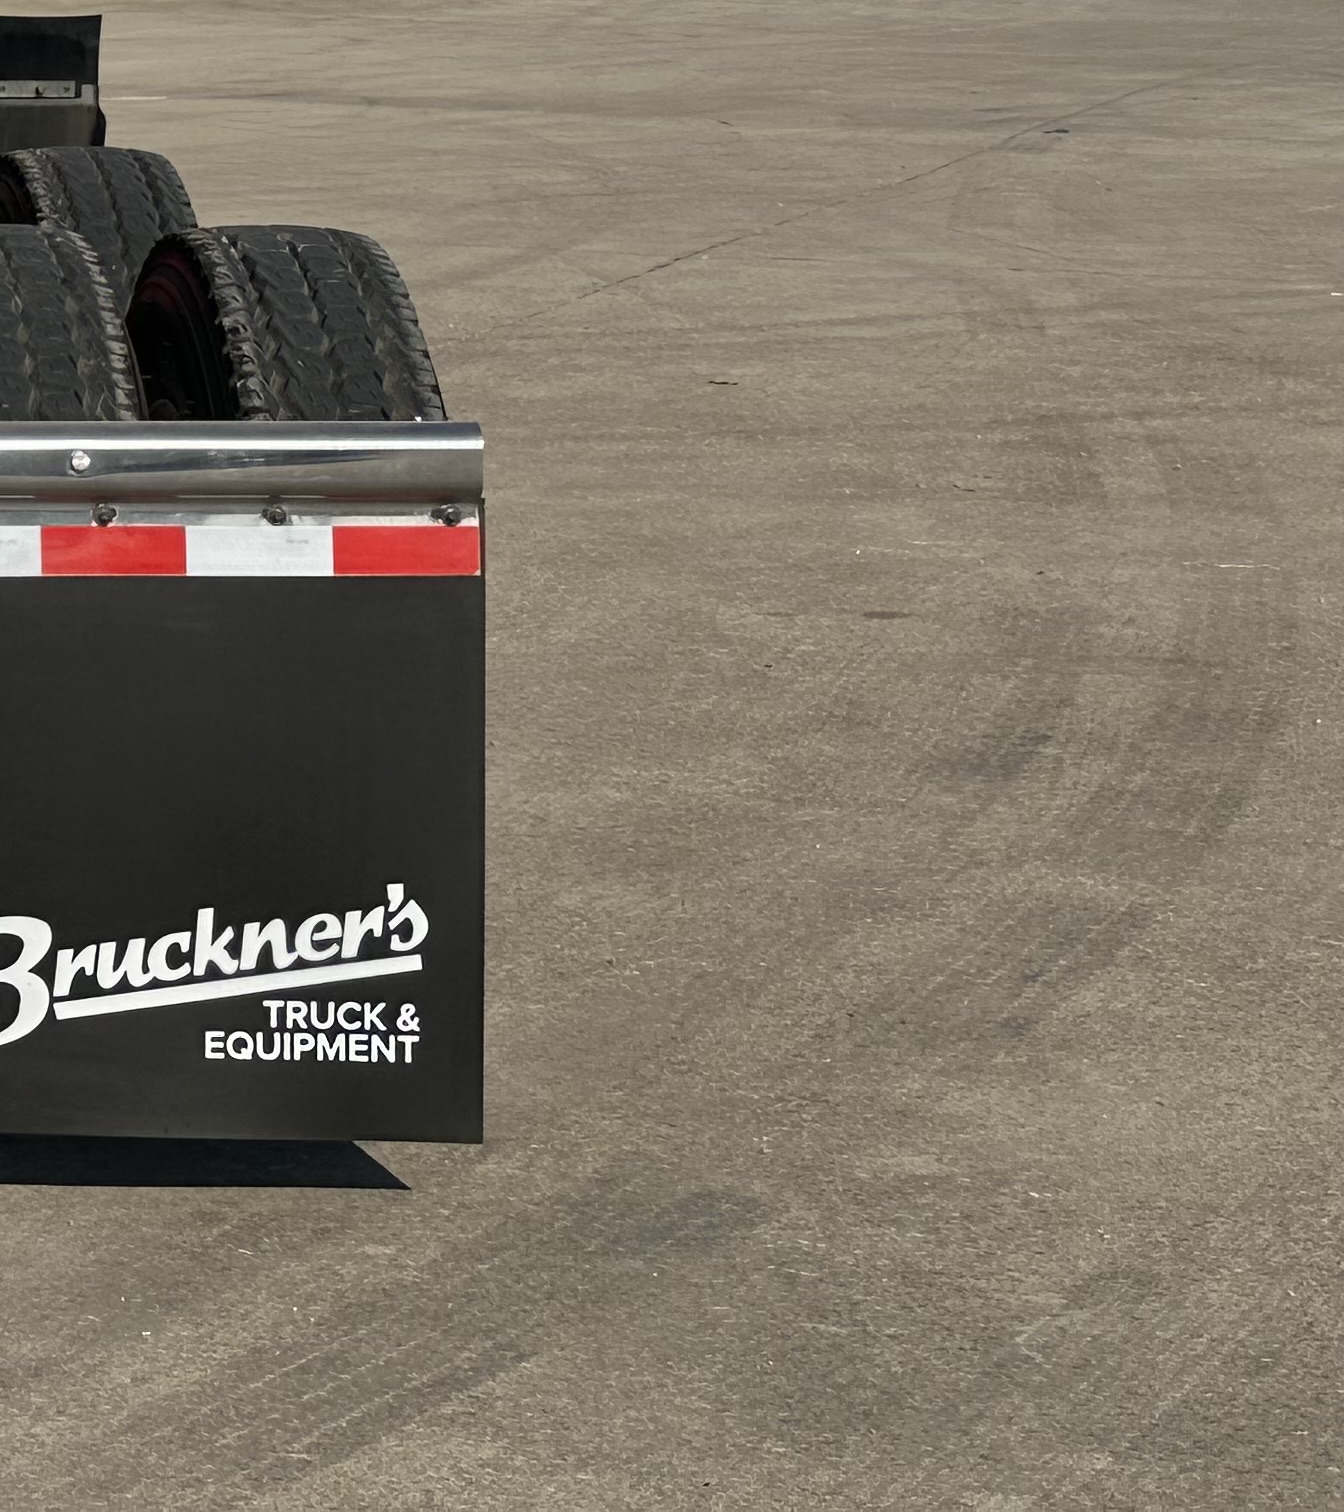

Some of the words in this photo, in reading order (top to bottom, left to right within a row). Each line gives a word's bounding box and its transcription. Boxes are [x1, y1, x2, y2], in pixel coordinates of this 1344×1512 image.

[262, 999, 387, 1032] TRUCK
[395, 1003, 421, 1032] &
[204, 1030, 421, 1064] EQUIPMENT
